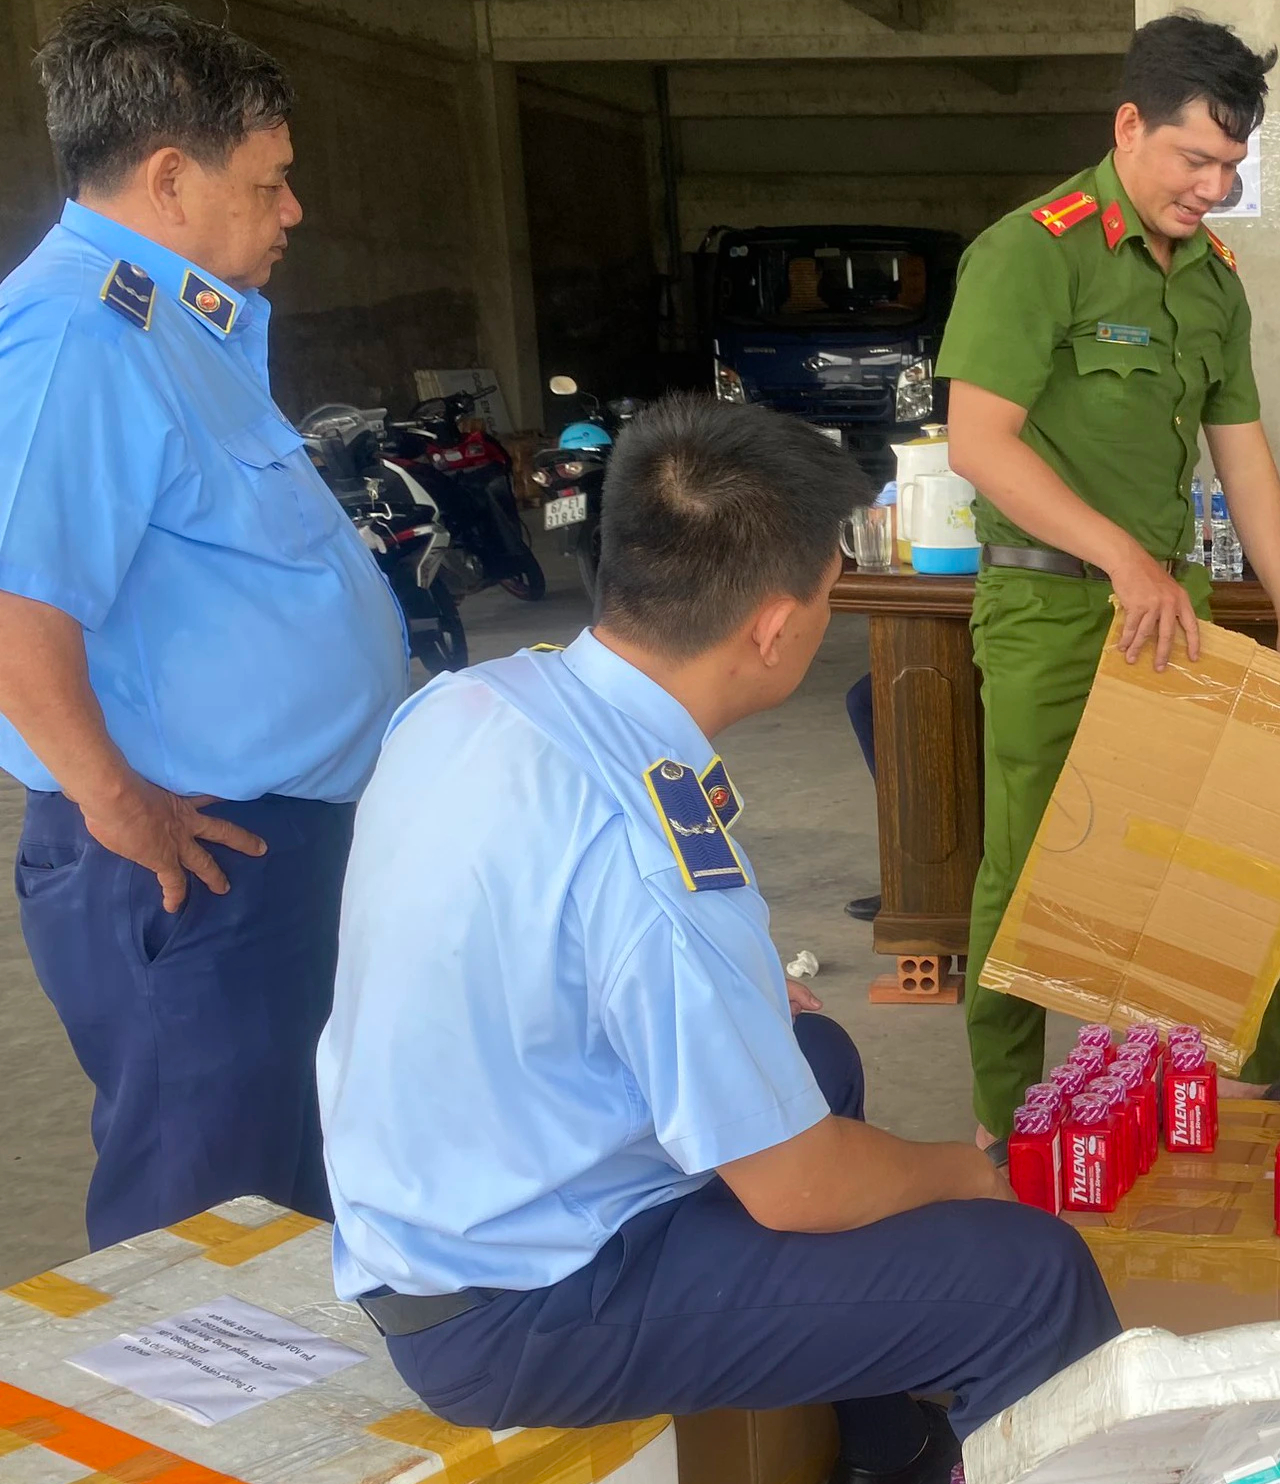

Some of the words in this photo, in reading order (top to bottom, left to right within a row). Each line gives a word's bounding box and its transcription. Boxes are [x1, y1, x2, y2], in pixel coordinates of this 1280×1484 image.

[1172, 1082, 1189, 1144] TYLENOL
[1071, 1136, 1088, 1203] TYLENOL
[230, 1346, 250, 1361] phẩm
[287, 1343, 302, 1355] VOV
